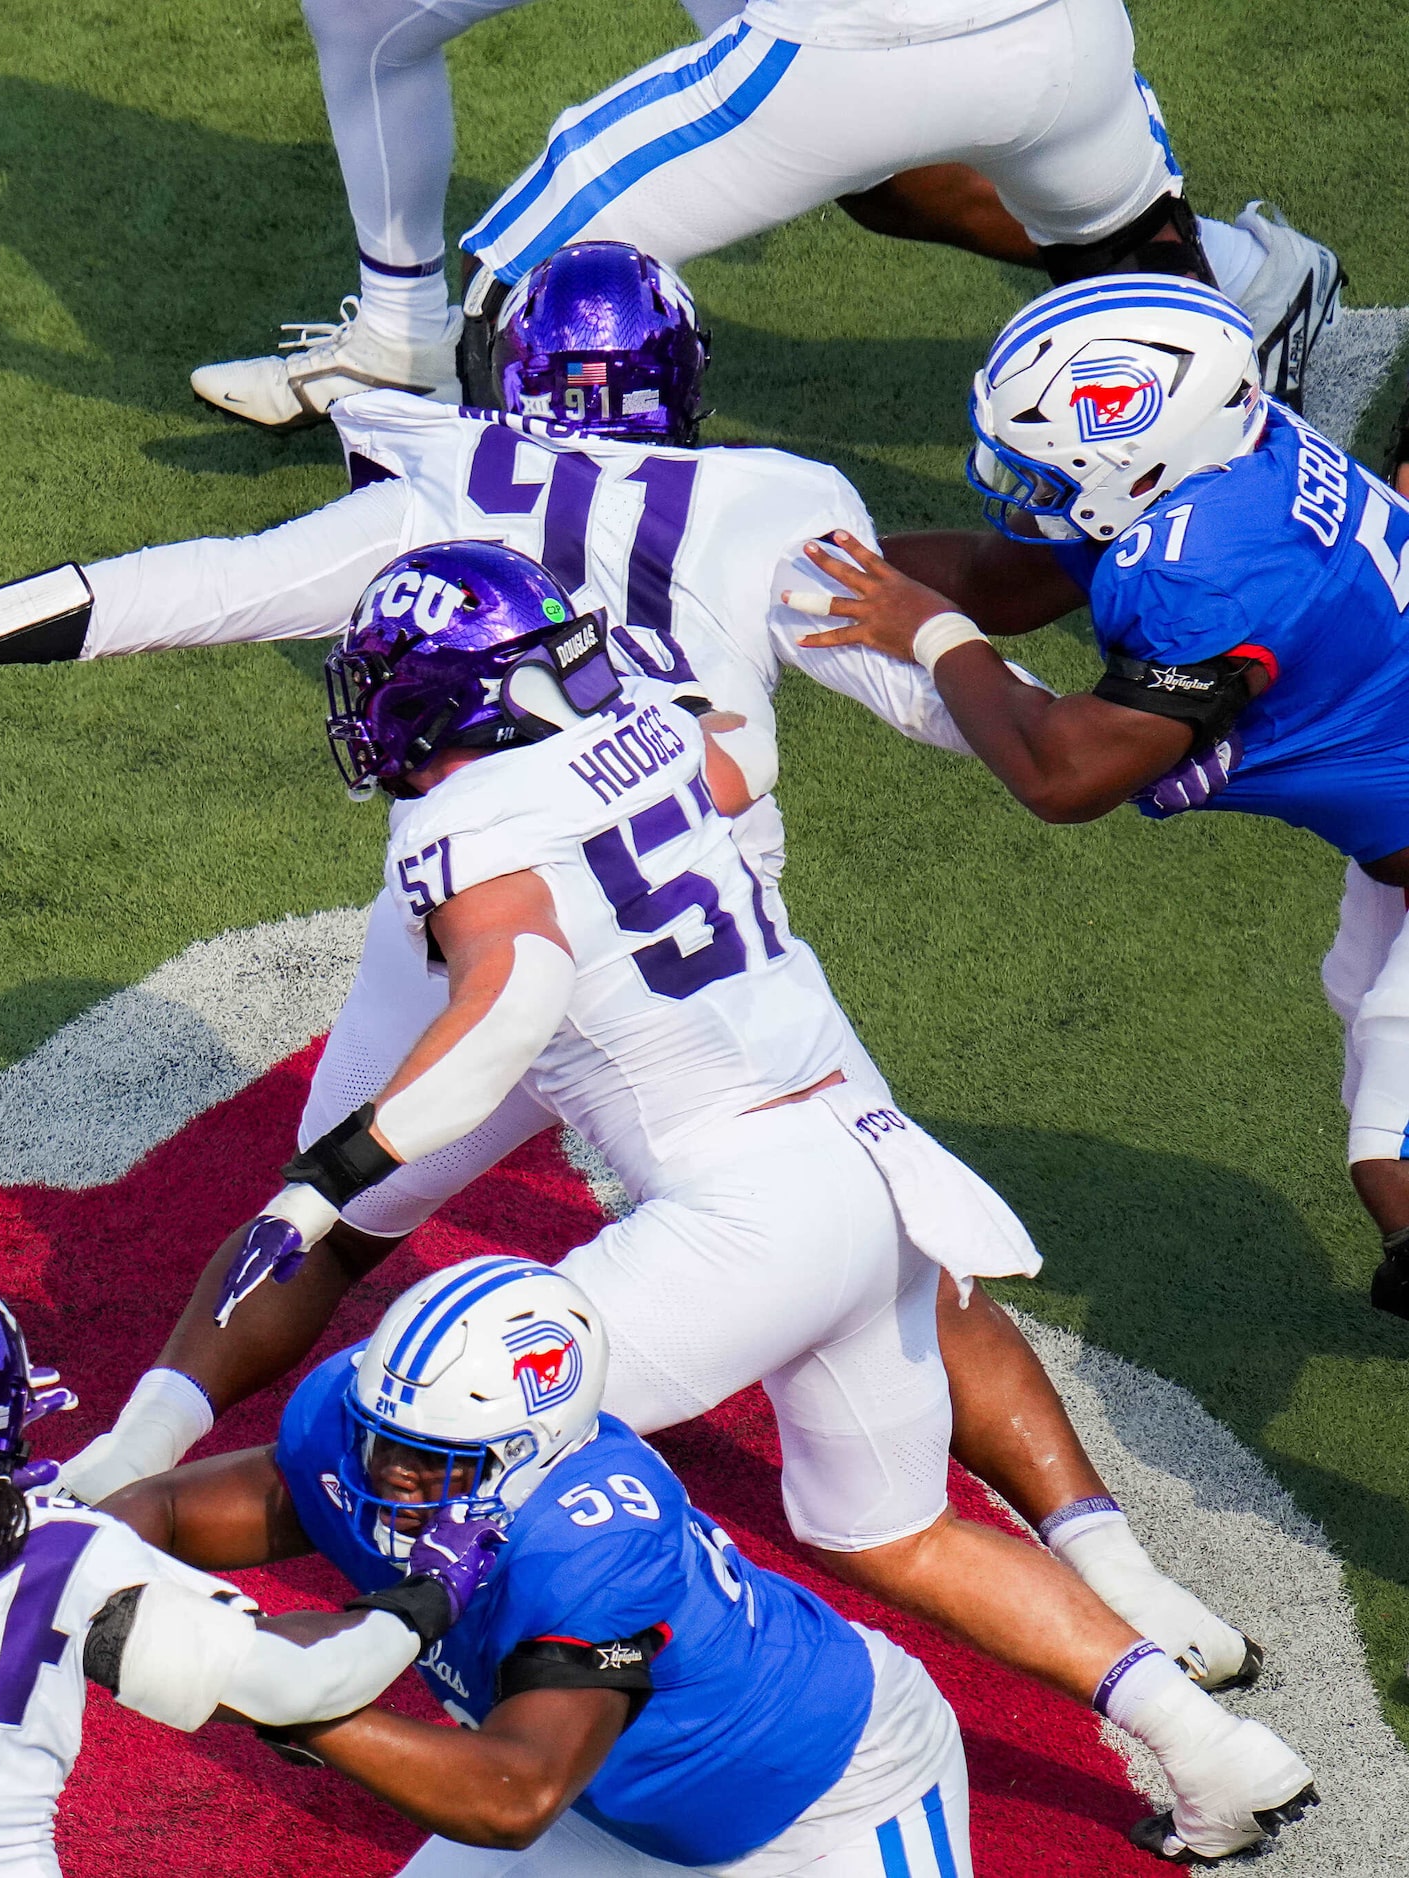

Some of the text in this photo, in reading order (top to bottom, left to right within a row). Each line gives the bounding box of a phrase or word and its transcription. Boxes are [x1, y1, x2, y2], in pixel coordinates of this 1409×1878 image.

[564, 386, 611, 422] 91
[452, 423, 700, 682] 91
[1114, 503, 1195, 569] 51
[355, 570, 469, 636] TCU
[1163, 674, 1211, 691] Douglas
[567, 704, 686, 806] HODGES
[397, 836, 455, 917] 57
[855, 1109, 906, 1142] TCU
[375, 1396, 398, 1418] 214
[556, 1473, 662, 1528] 59
[417, 1639, 470, 1699] las
[1103, 1654, 1138, 1688] NIKE
